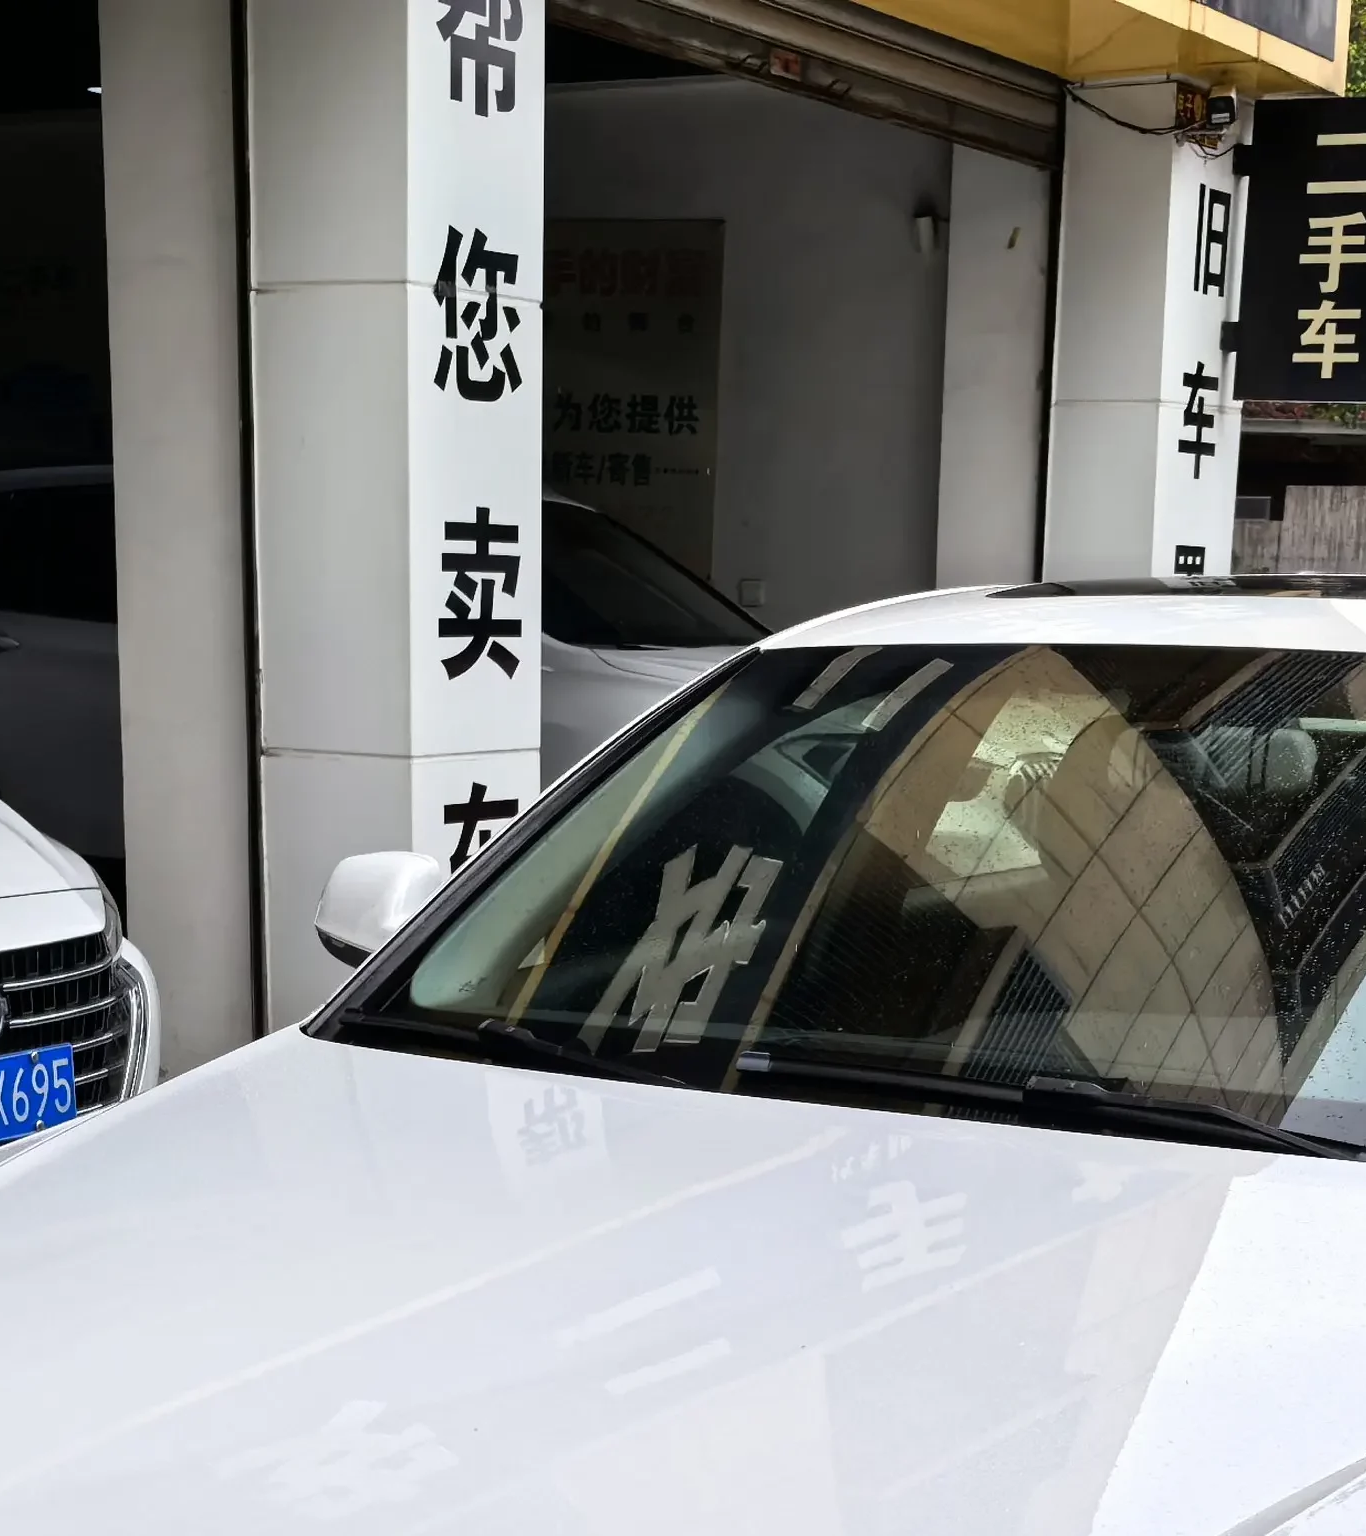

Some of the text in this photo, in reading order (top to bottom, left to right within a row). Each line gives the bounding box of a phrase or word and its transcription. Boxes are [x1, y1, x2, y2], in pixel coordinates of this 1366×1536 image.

[553, 392, 700, 435] 为您提供
[1173, 183, 1232, 576] 旧车
